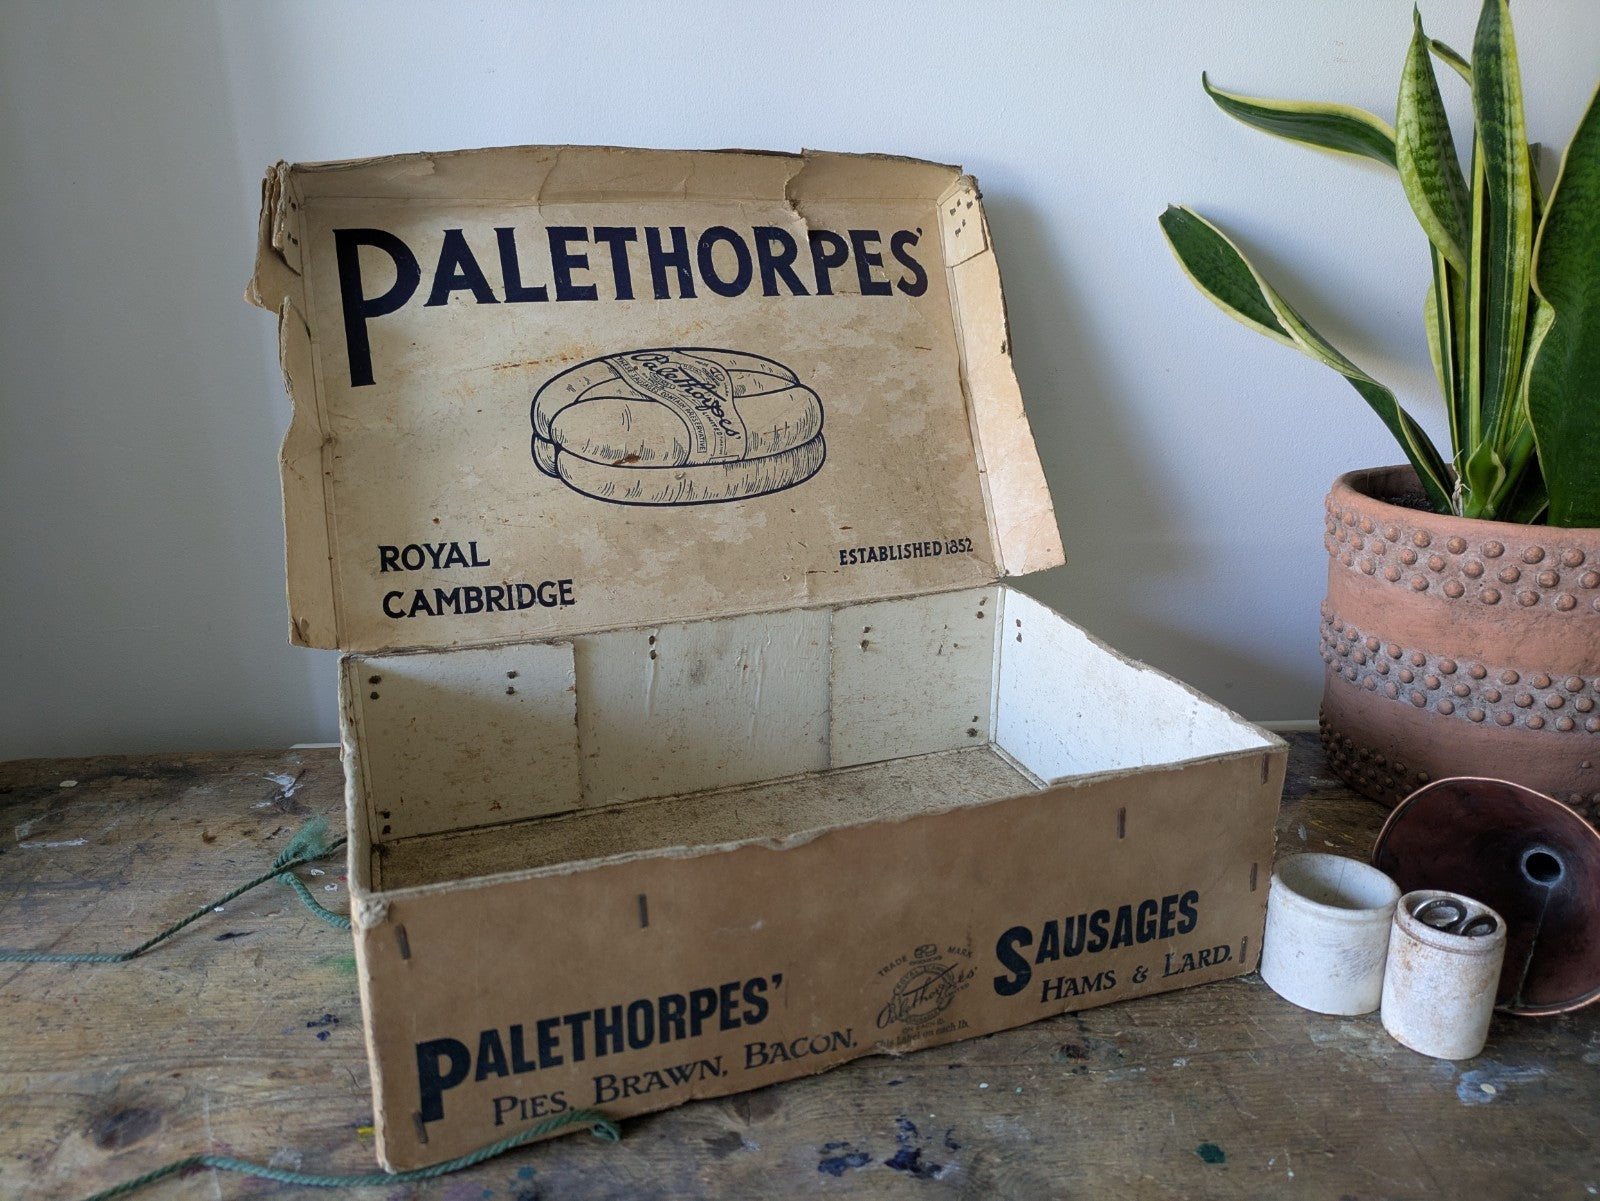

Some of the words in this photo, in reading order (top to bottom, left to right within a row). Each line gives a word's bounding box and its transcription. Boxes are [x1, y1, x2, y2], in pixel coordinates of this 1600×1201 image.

[332, 225, 929, 388] PALETHORPES'
[631, 372, 660, 395] SAUSAGES
[660, 391, 687, 410] CONTAIN
[686, 407, 707, 453] PRESERVATIVE
[702, 411, 723, 437] LIMITED
[377, 541, 491, 573] ROYAL
[839, 540, 943, 566] ESTABLISHED
[945, 537, 974, 555] 1852
[382, 578, 575, 619] CAMBRIDGE
[878, 955, 908, 977] TRADE
[947, 945, 974, 959] MARK
[993, 889, 1200, 997] SAUSAGES
[1040, 969, 1117, 1003] HAMS
[1132, 964, 1150, 984] &
[415, 973, 784, 1124] PALETHORPES'
